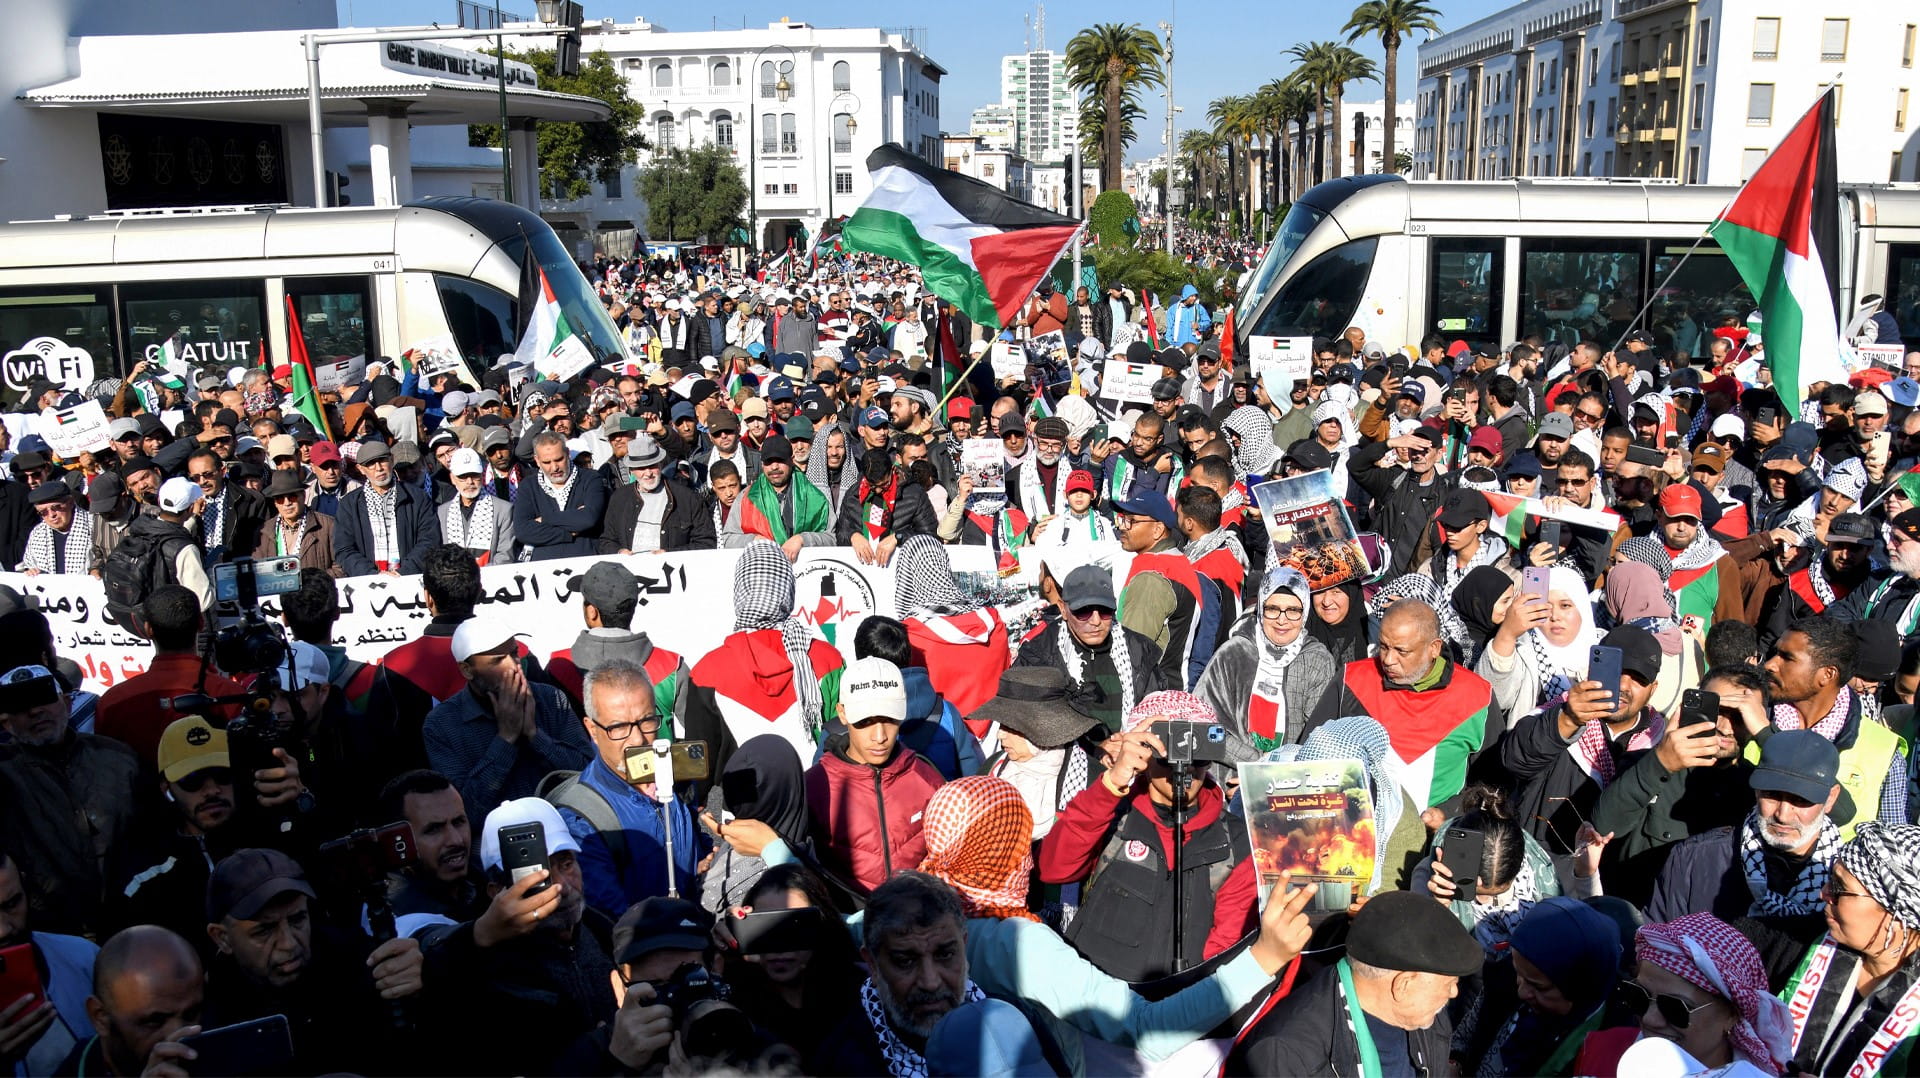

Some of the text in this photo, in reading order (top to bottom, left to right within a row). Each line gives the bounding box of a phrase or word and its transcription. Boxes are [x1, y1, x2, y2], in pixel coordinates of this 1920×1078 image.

[387, 42, 415, 65] GARE
[1411, 224, 1426, 232] 023
[373, 260, 390, 270] 041
[145, 341, 250, 364] GATUIT
[1862, 352, 1898, 362] STAND UP
[1276, 513, 1290, 524] غزة
[1316, 506, 1329, 516] عن
[225, 582, 296, 599] Sreme
[68, 630, 106, 649] شعار
[1265, 777, 1302, 795] حصار
[1269, 793, 1344, 813] غزة تحت النار
